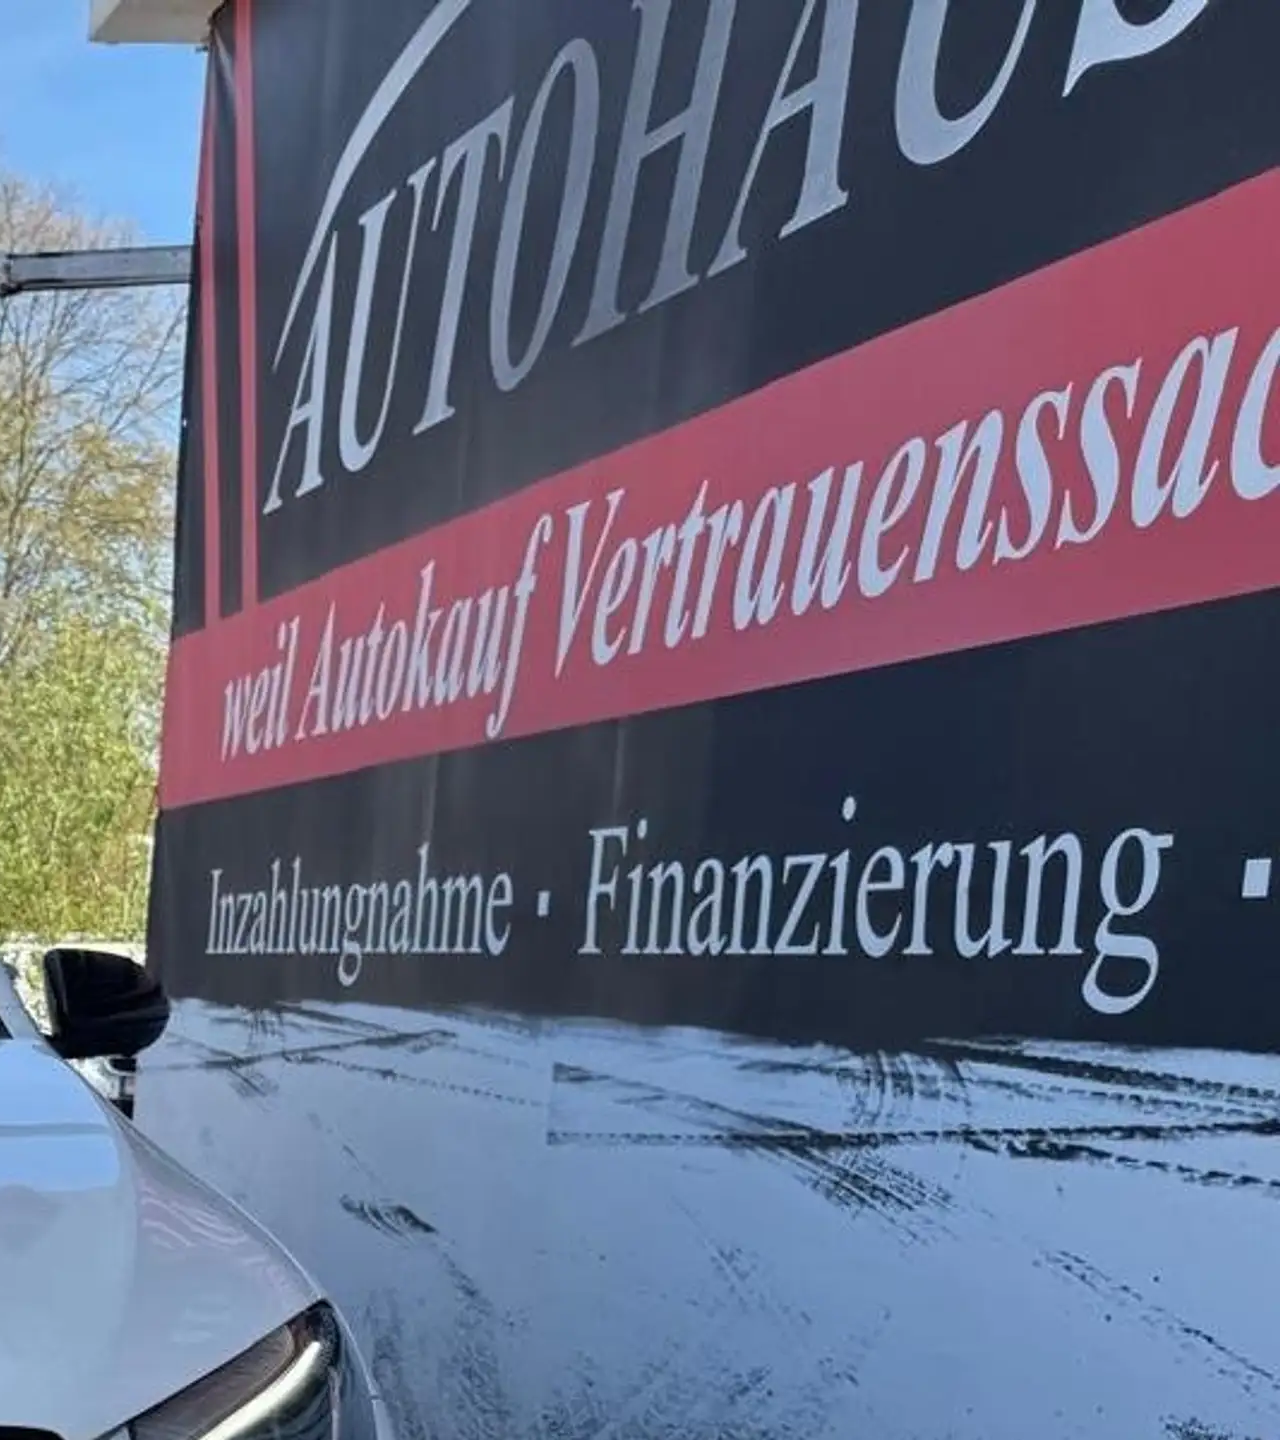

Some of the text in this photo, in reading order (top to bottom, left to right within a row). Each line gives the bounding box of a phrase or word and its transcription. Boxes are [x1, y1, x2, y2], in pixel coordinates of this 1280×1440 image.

[263, 0, 1208, 514] AUTOHA
[221, 616, 299, 761] weil
[299, 517, 550, 739] Autokauf
[205, 797, 1174, 1013] Inzahlungnahme Finanzierung
